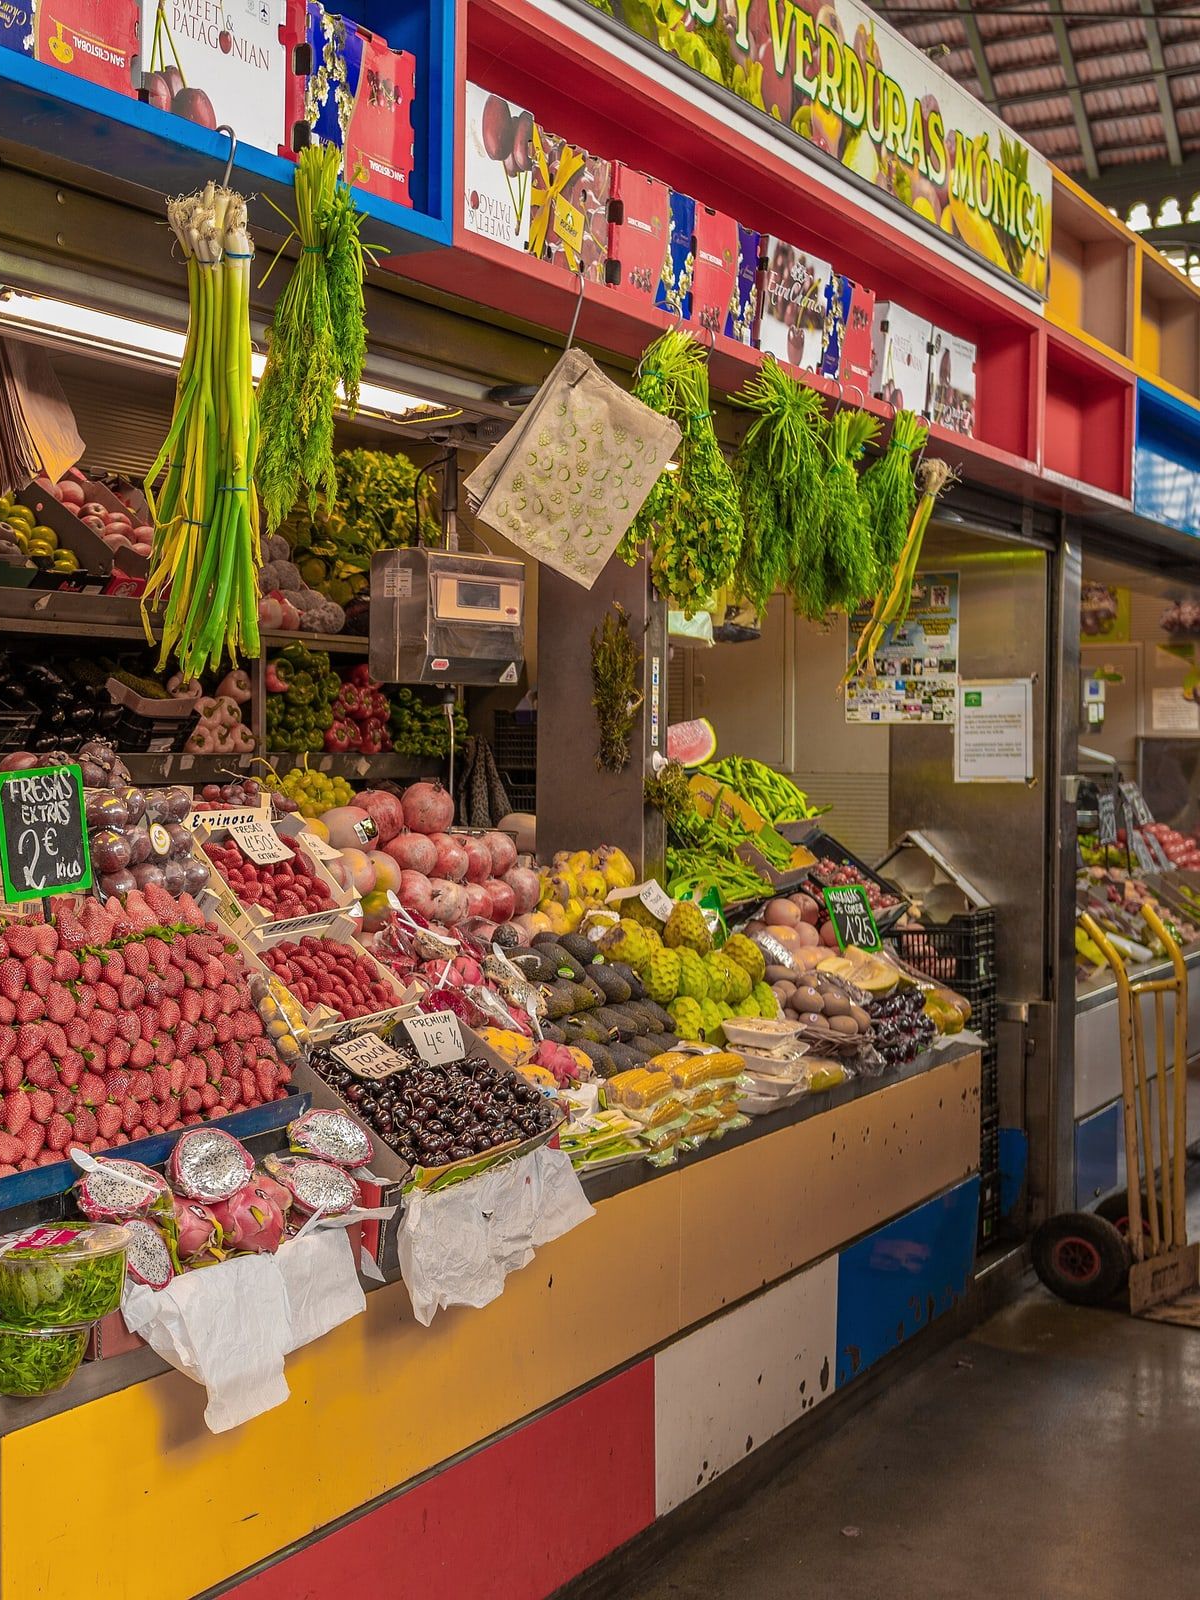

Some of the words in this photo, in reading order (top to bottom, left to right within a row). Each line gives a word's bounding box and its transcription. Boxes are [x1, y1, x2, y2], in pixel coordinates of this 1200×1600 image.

[73, 36, 109, 61] CRISTOBAL
[110, 53, 125, 67] SAN
[768, 0, 947, 187] VERDURAS
[950, 129, 1046, 257] MÓNICA
[5, 768, 72, 802] FRESAS
[21, 801, 71, 825] EXTRAS
[409, 1014, 451, 1028] PREMIUM
[339, 1035, 377, 1056] DON'T
[351, 1045, 389, 1066] TOUCH
